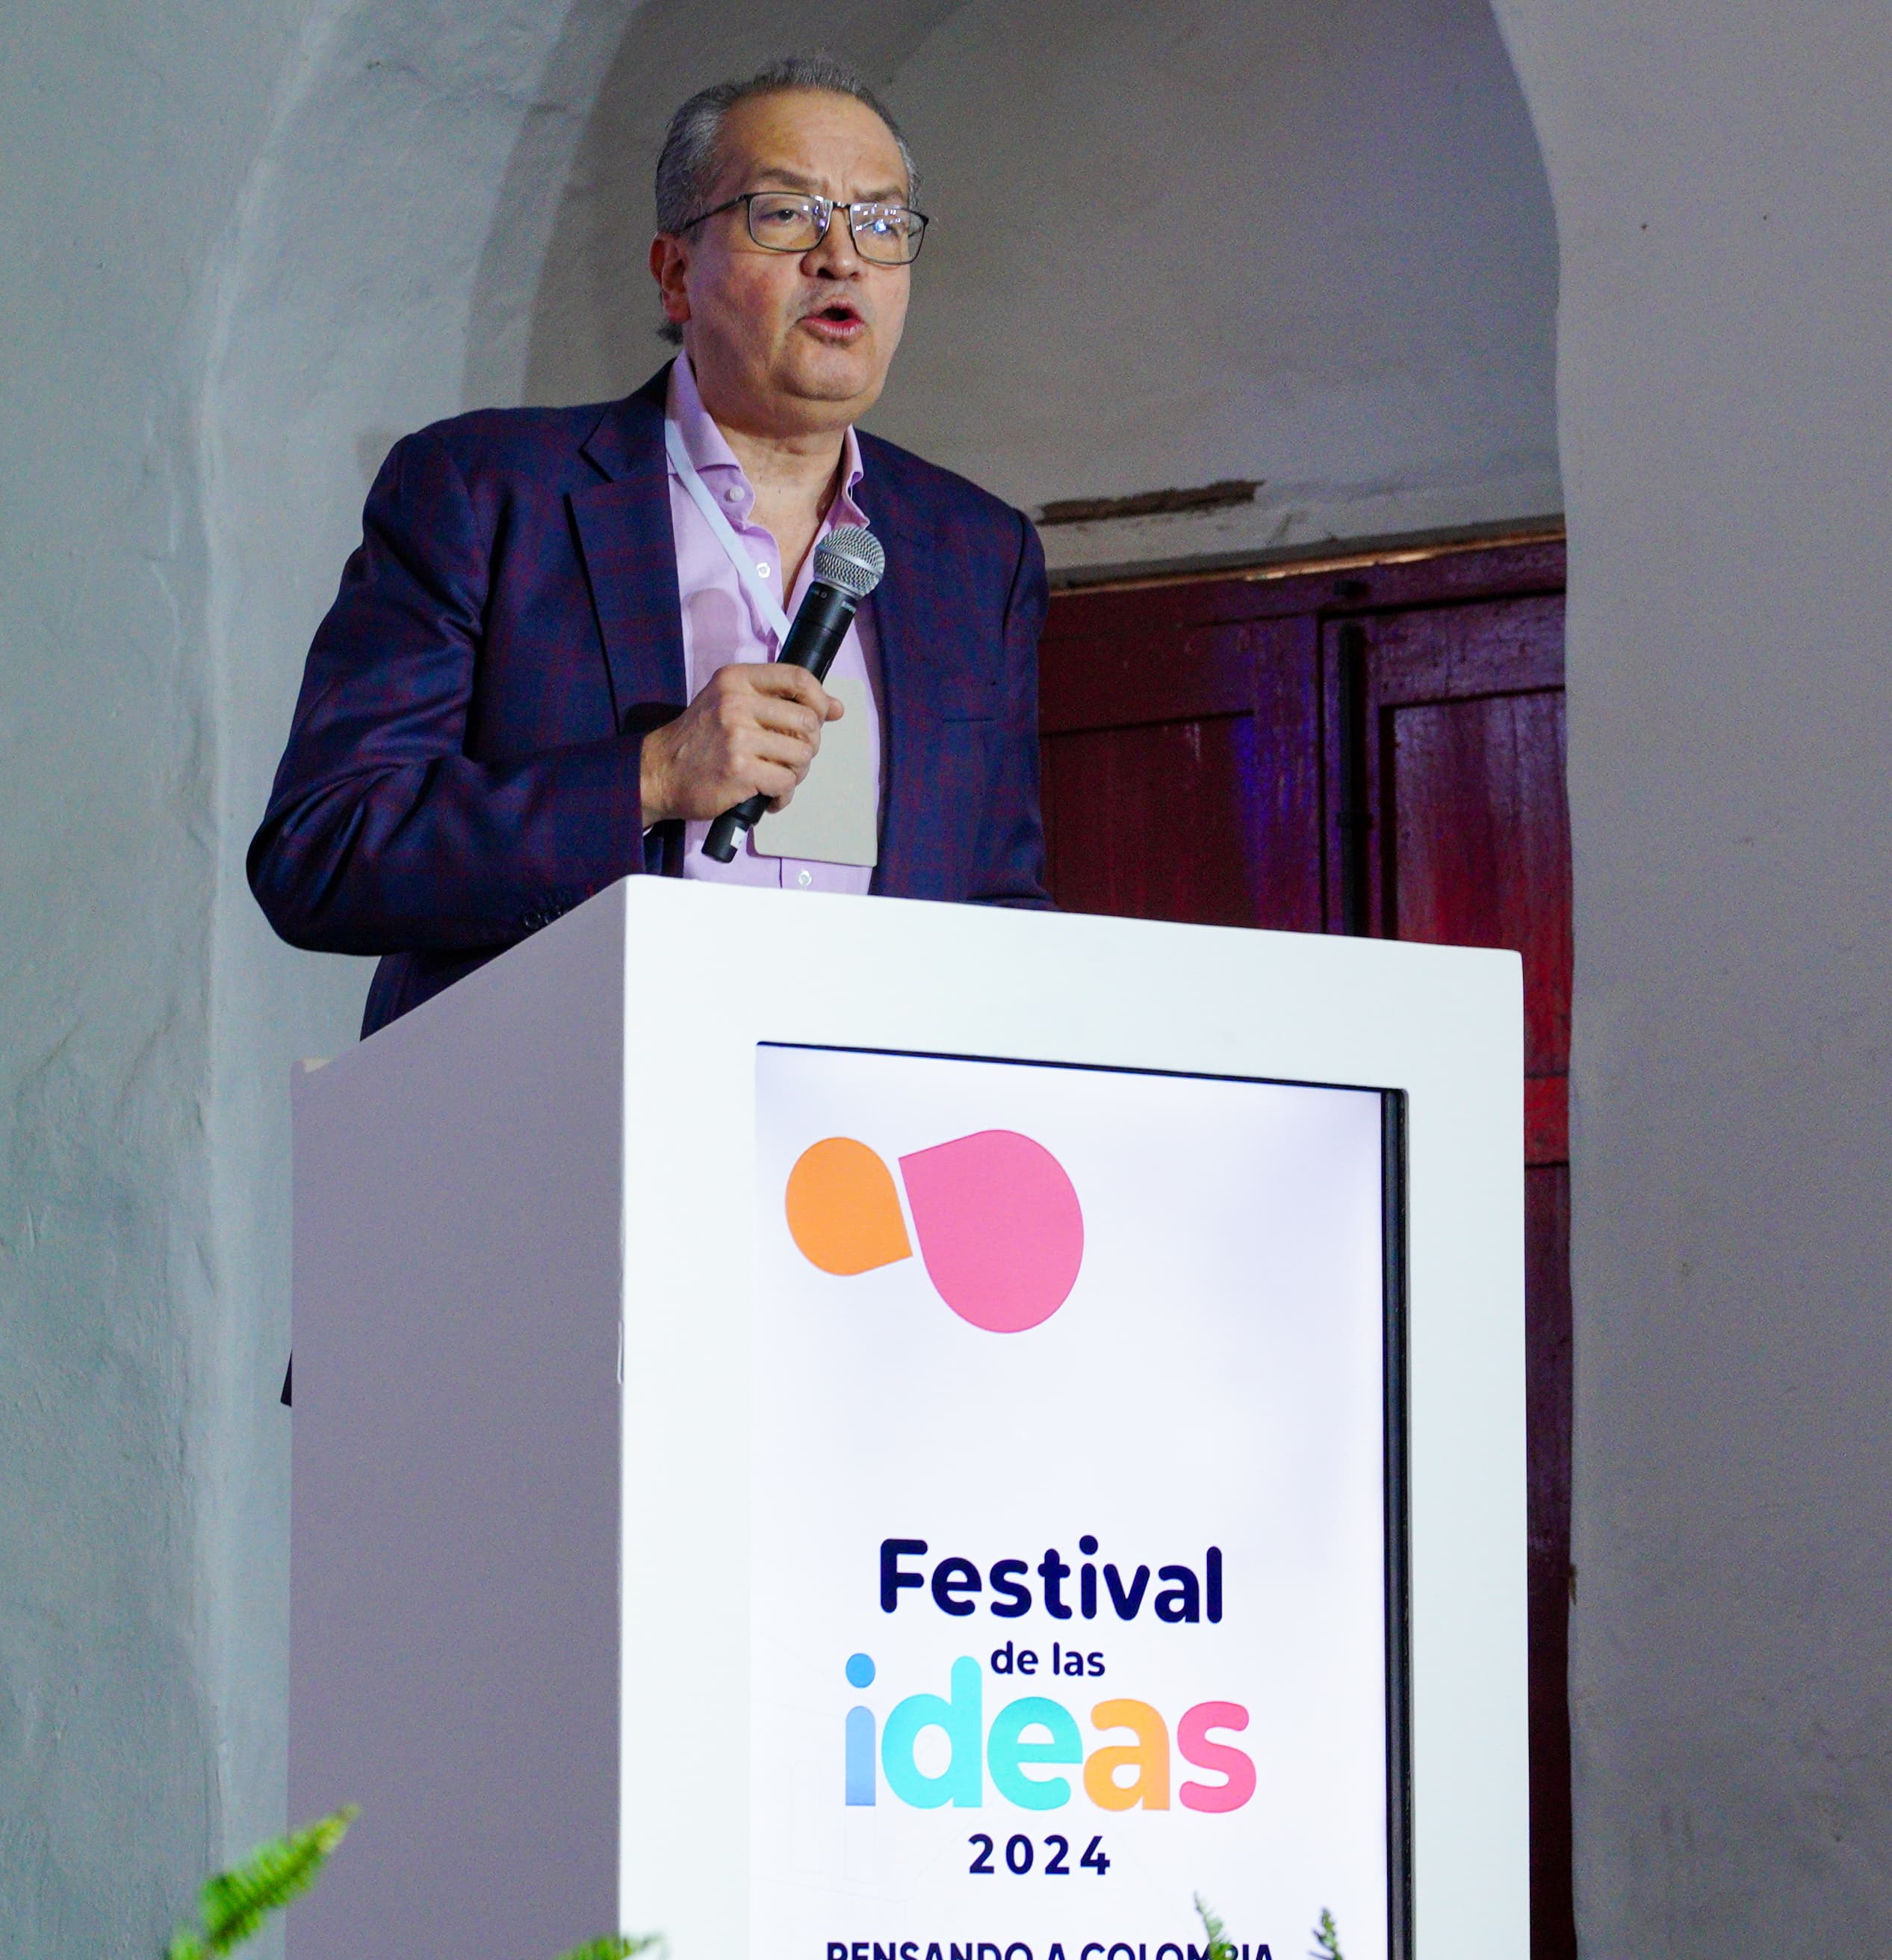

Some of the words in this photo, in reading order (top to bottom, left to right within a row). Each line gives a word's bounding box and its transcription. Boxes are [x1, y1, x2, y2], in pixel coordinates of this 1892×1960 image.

[880, 1535, 1223, 1625] Festival
[990, 1641, 1040, 1676] de
[1053, 1642, 1106, 1678] las
[845, 1653, 1258, 1814] ideas
[969, 1834, 1111, 1876] 2024
[827, 1942, 1034, 1960] PENSANDO
[1049, 1944, 1068, 1960] A
[1080, 1943, 1274, 1960] COLOMIA
